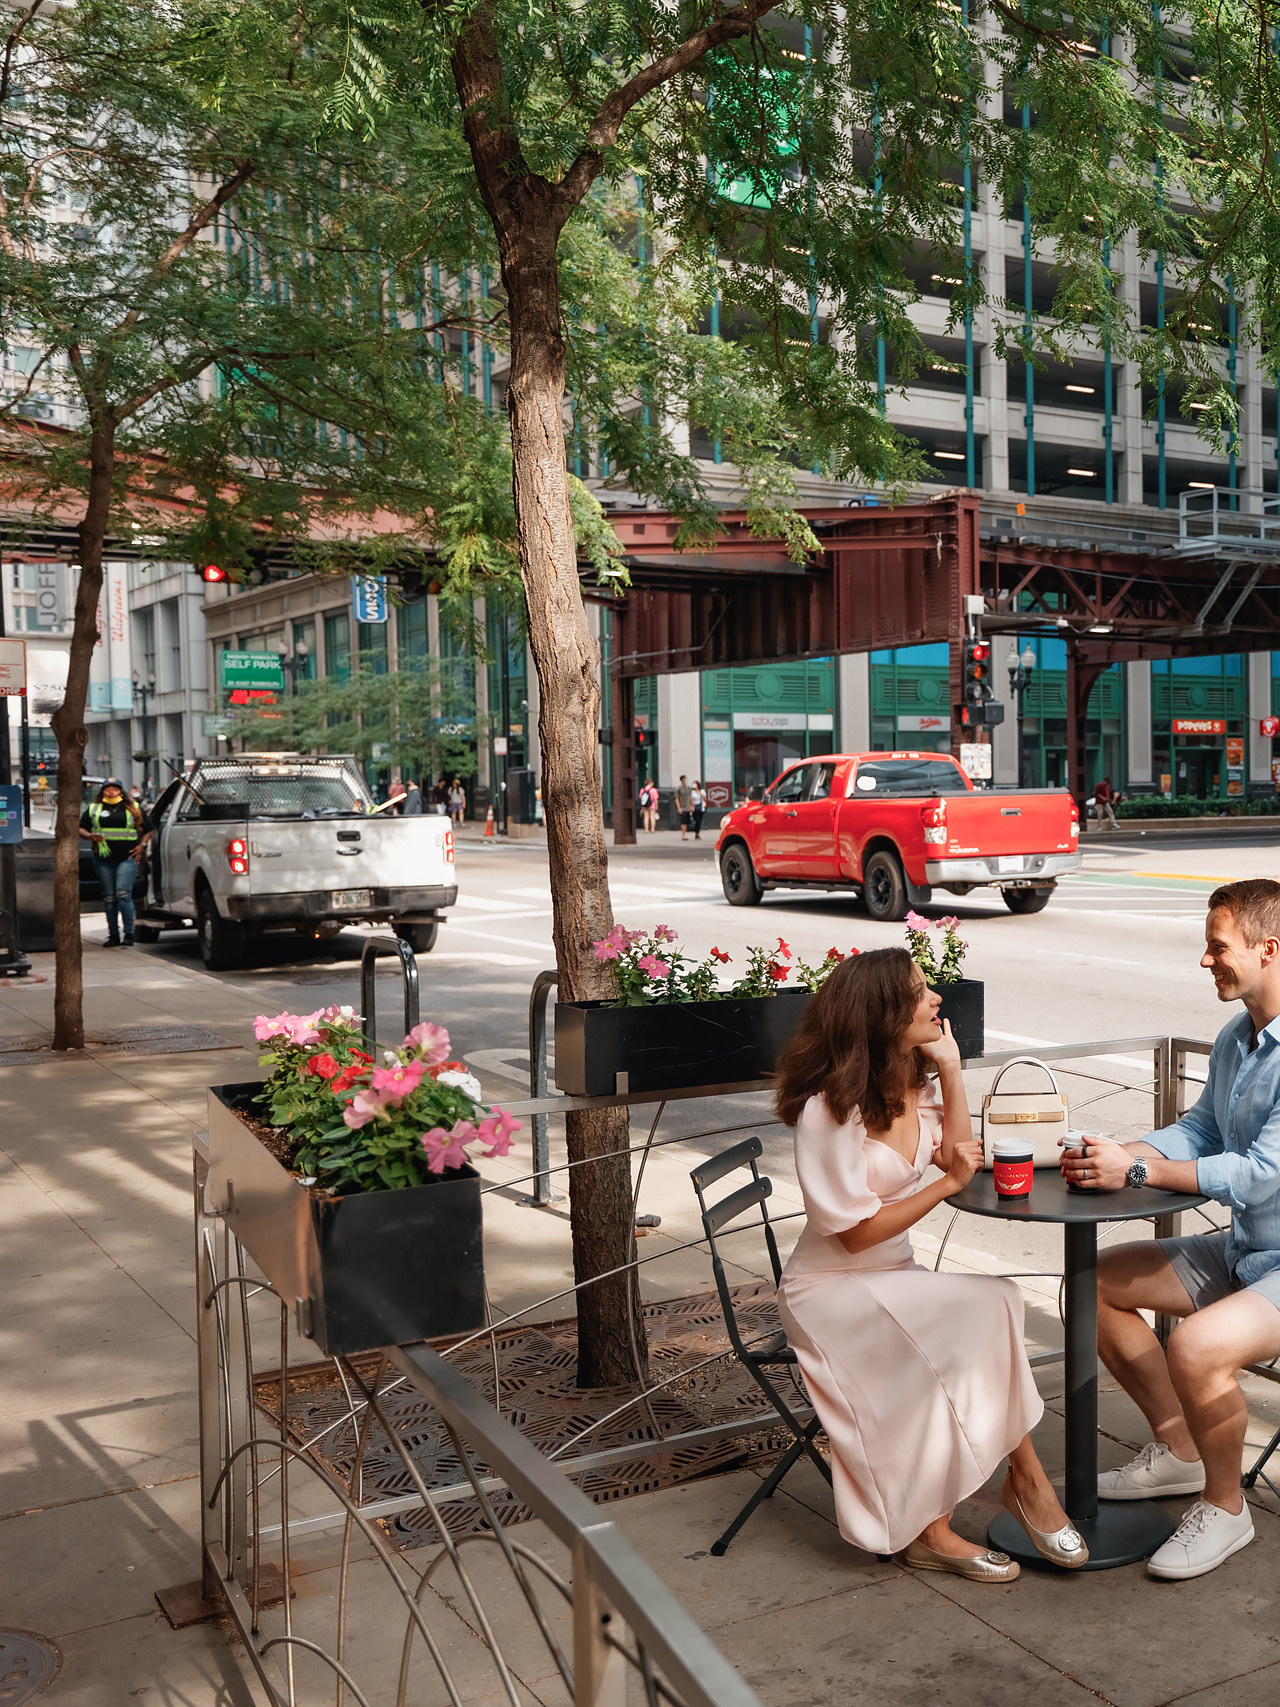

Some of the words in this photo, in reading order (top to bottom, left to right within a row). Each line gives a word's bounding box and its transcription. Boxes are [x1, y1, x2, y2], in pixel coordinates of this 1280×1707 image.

[38, 563, 57, 622] JOFF
[224, 660, 251, 669] SELF
[252, 660, 281, 669] PARK
